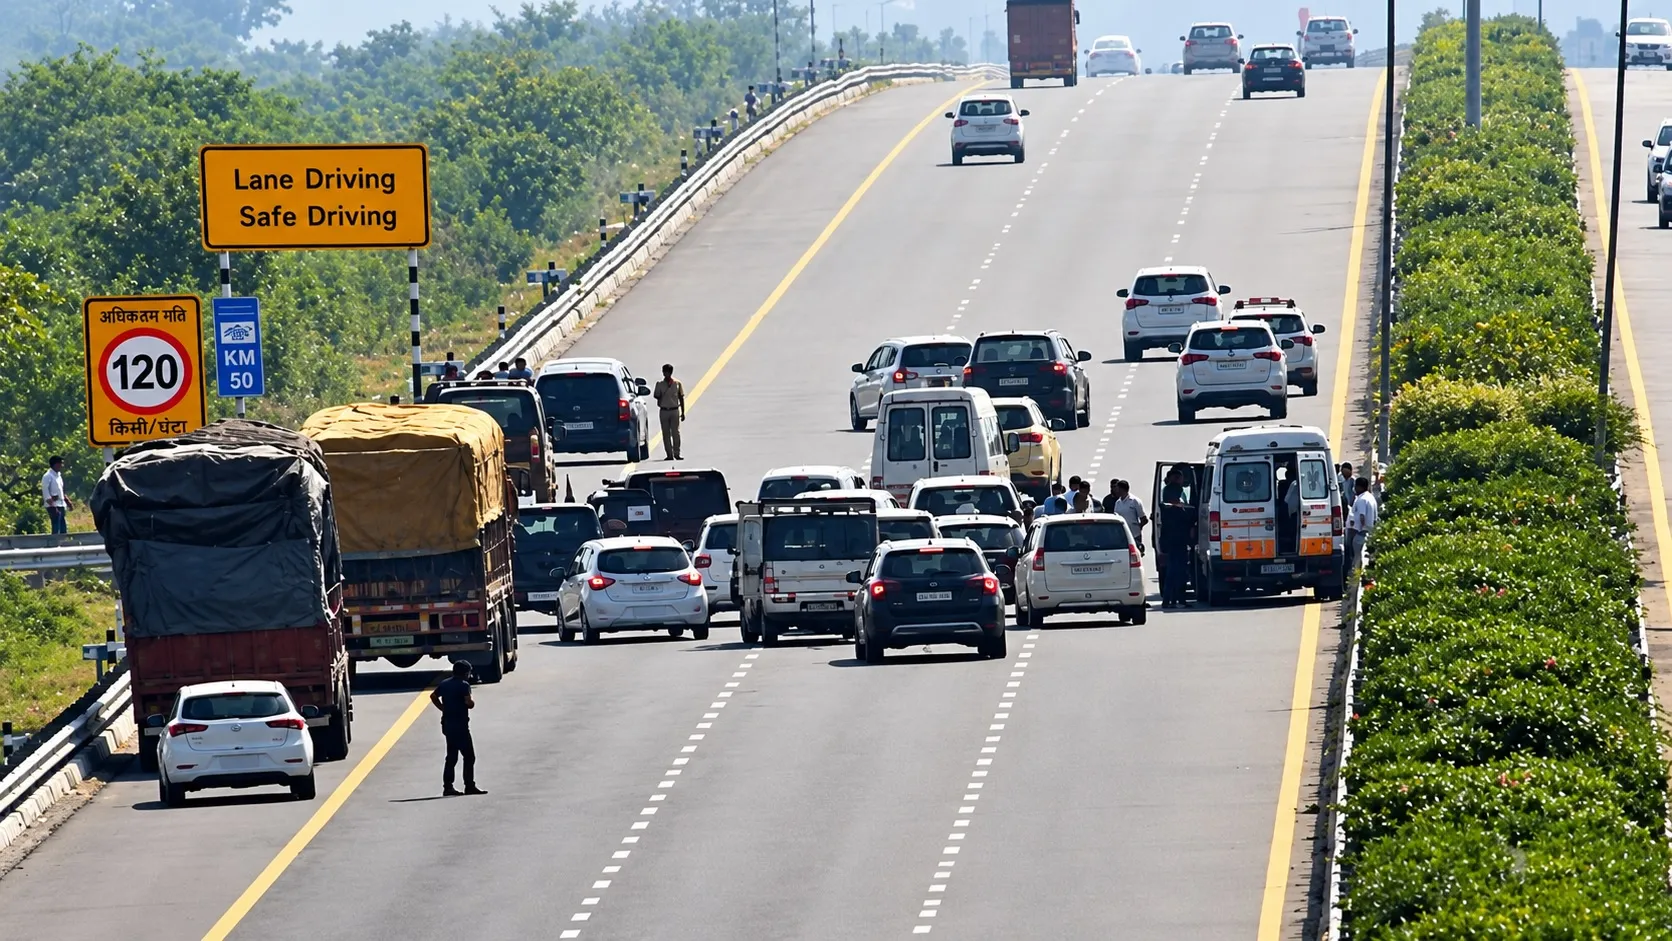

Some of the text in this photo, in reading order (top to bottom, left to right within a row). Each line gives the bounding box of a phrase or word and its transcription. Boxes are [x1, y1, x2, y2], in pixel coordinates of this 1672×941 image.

[234, 167, 395, 195] Lane Driving
[239, 204, 397, 232] Safe Driving
[224, 349, 255, 366] KM
[112, 354, 179, 390] 120
[230, 371, 253, 389] 50
